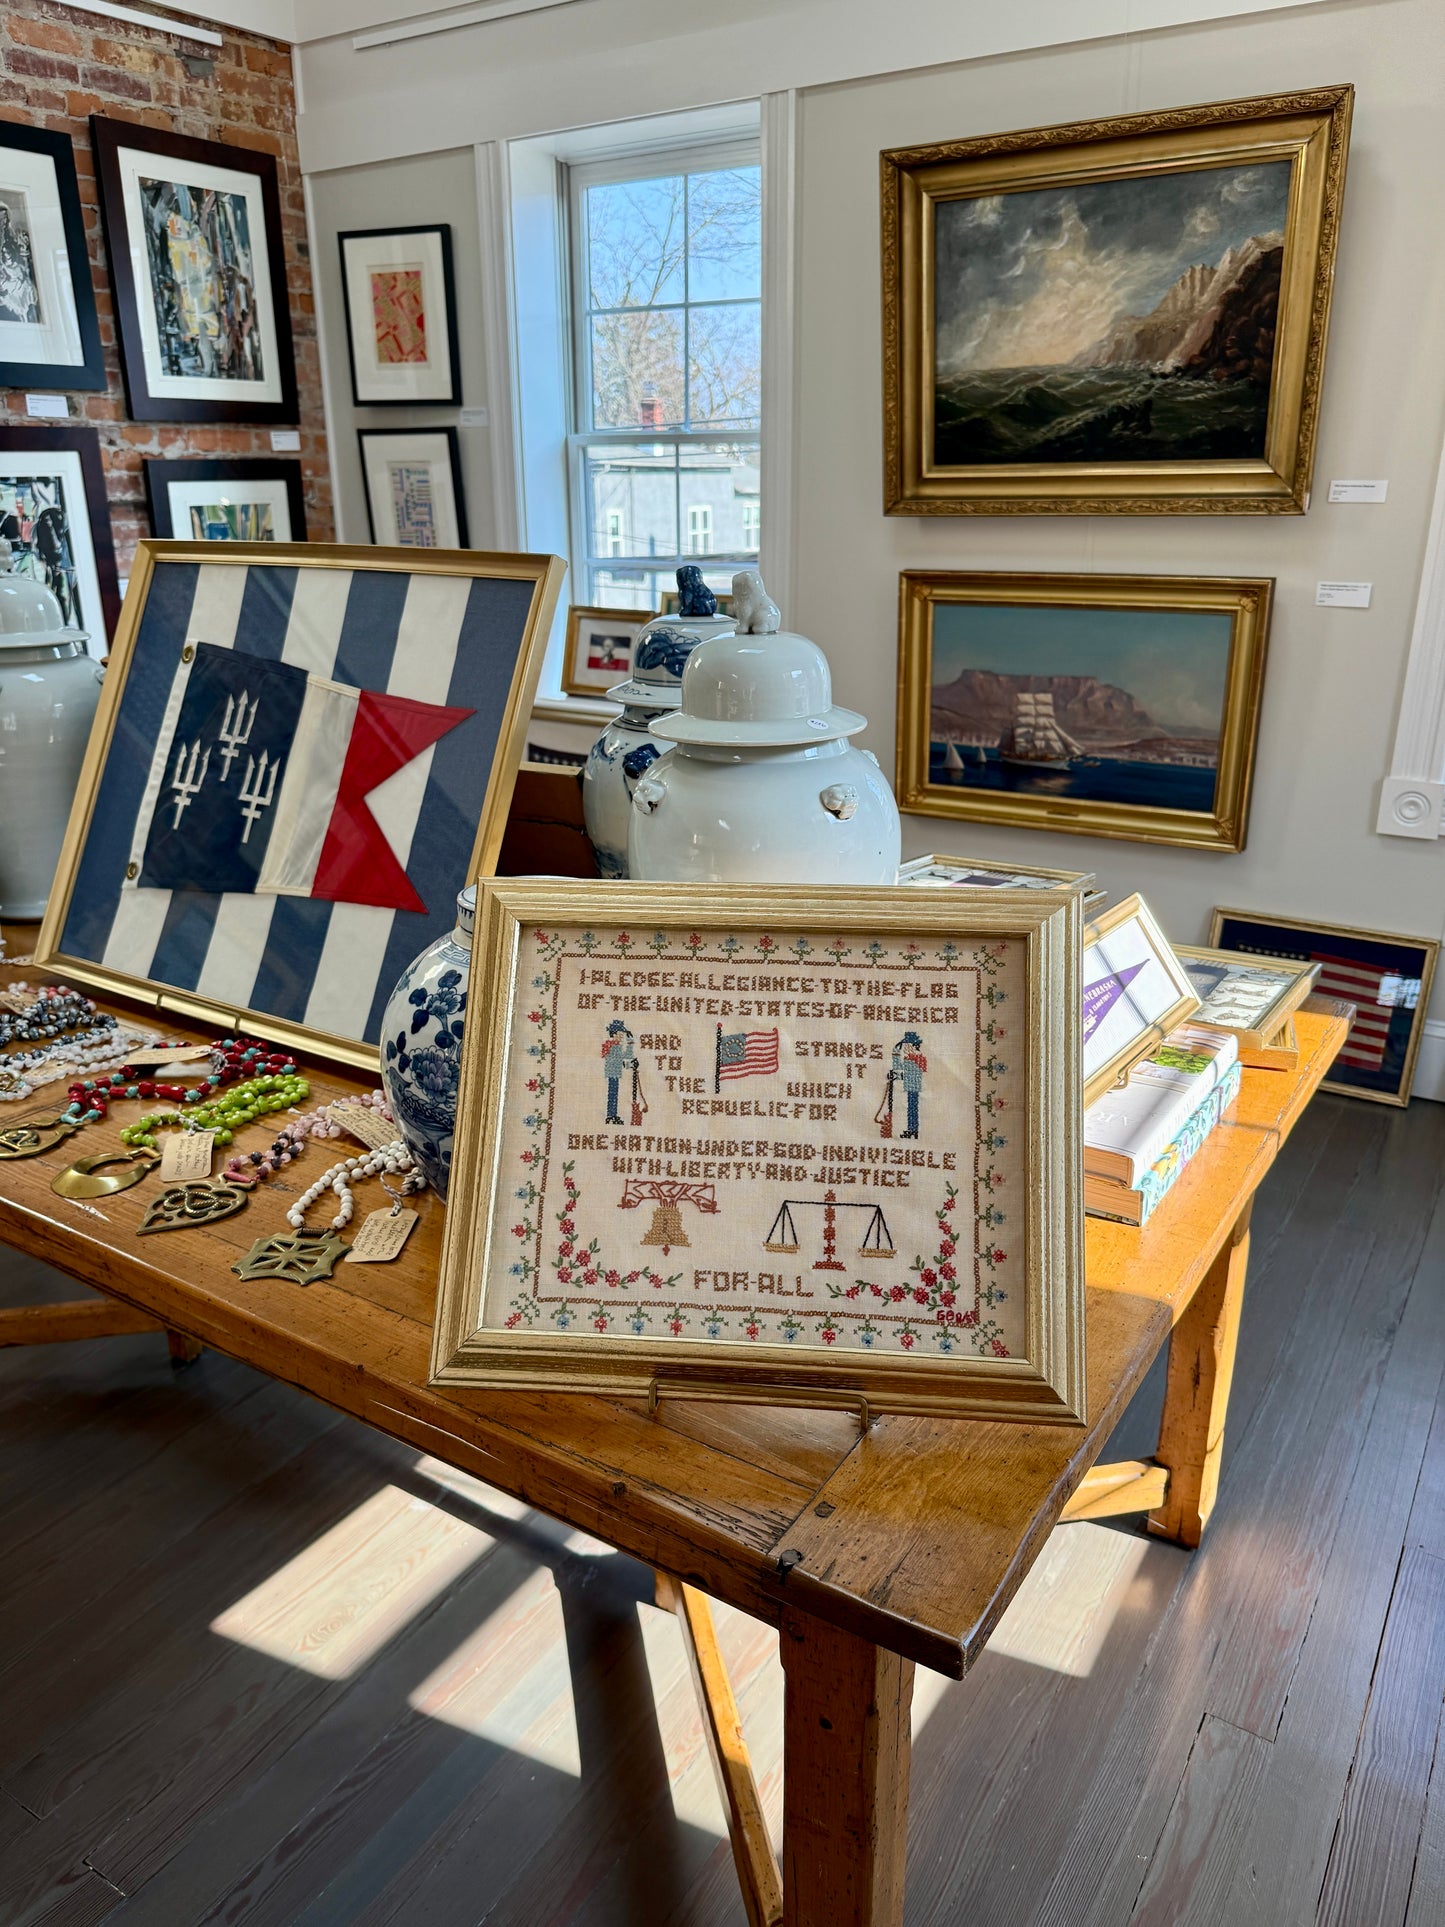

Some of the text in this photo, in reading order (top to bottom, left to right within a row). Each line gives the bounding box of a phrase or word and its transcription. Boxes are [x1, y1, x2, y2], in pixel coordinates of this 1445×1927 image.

[590, 969, 675, 987] PLEDGE
[679, 971, 814, 993] ALLEGIANCE
[820, 977, 848, 995] TO
[852, 979, 895, 996] THE
[900, 982, 959, 999] FLAG
[577, 993, 959, 1024] OF THE UNITED STATES OF AMERICA
[640, 1033, 682, 1051] AND
[795, 1040, 883, 1060] STANDS
[655, 1054, 682, 1071] TO
[846, 1063, 868, 1079] IT
[665, 1075, 706, 1094] THE
[786, 1081, 852, 1099] WHICH
[793, 1103, 837, 1121] FOR
[567, 1133, 957, 1171] ONE NATION UNDER GOD INDIVISIBLE
[612, 1156, 910, 1188] WITH LIBERTY AND JUSTICE
[694, 1269, 814, 1297] FOR ALL
